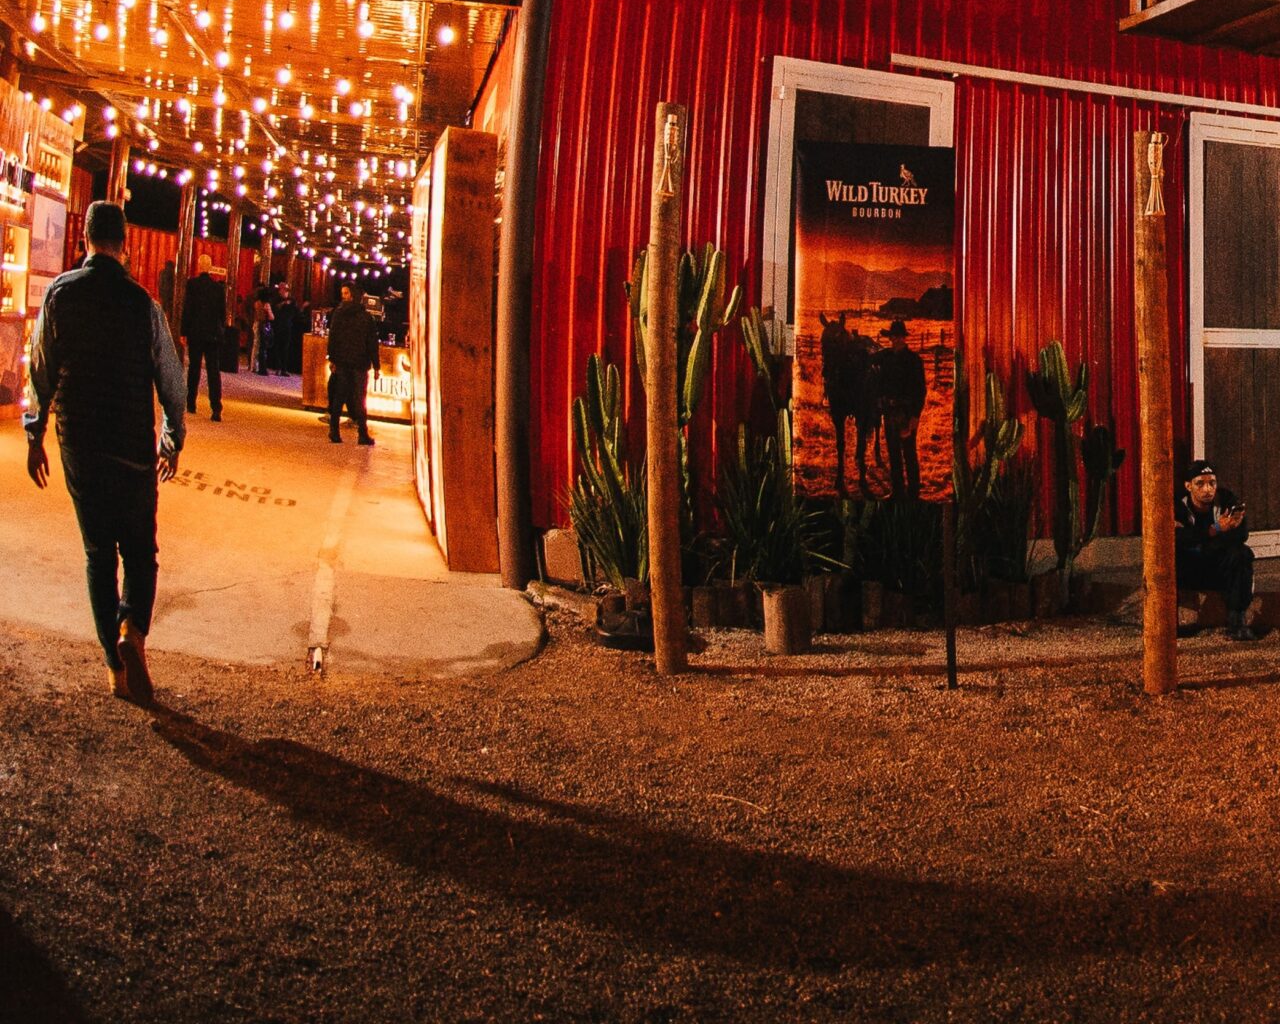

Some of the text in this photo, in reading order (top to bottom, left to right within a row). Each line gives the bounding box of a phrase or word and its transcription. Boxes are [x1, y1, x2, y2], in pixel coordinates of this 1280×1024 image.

[826, 180, 928, 206] WILD TURKEY
[852, 206, 901, 219] BOURBON
[170, 476, 297, 507] STINTO
[224, 479, 272, 495] NO
